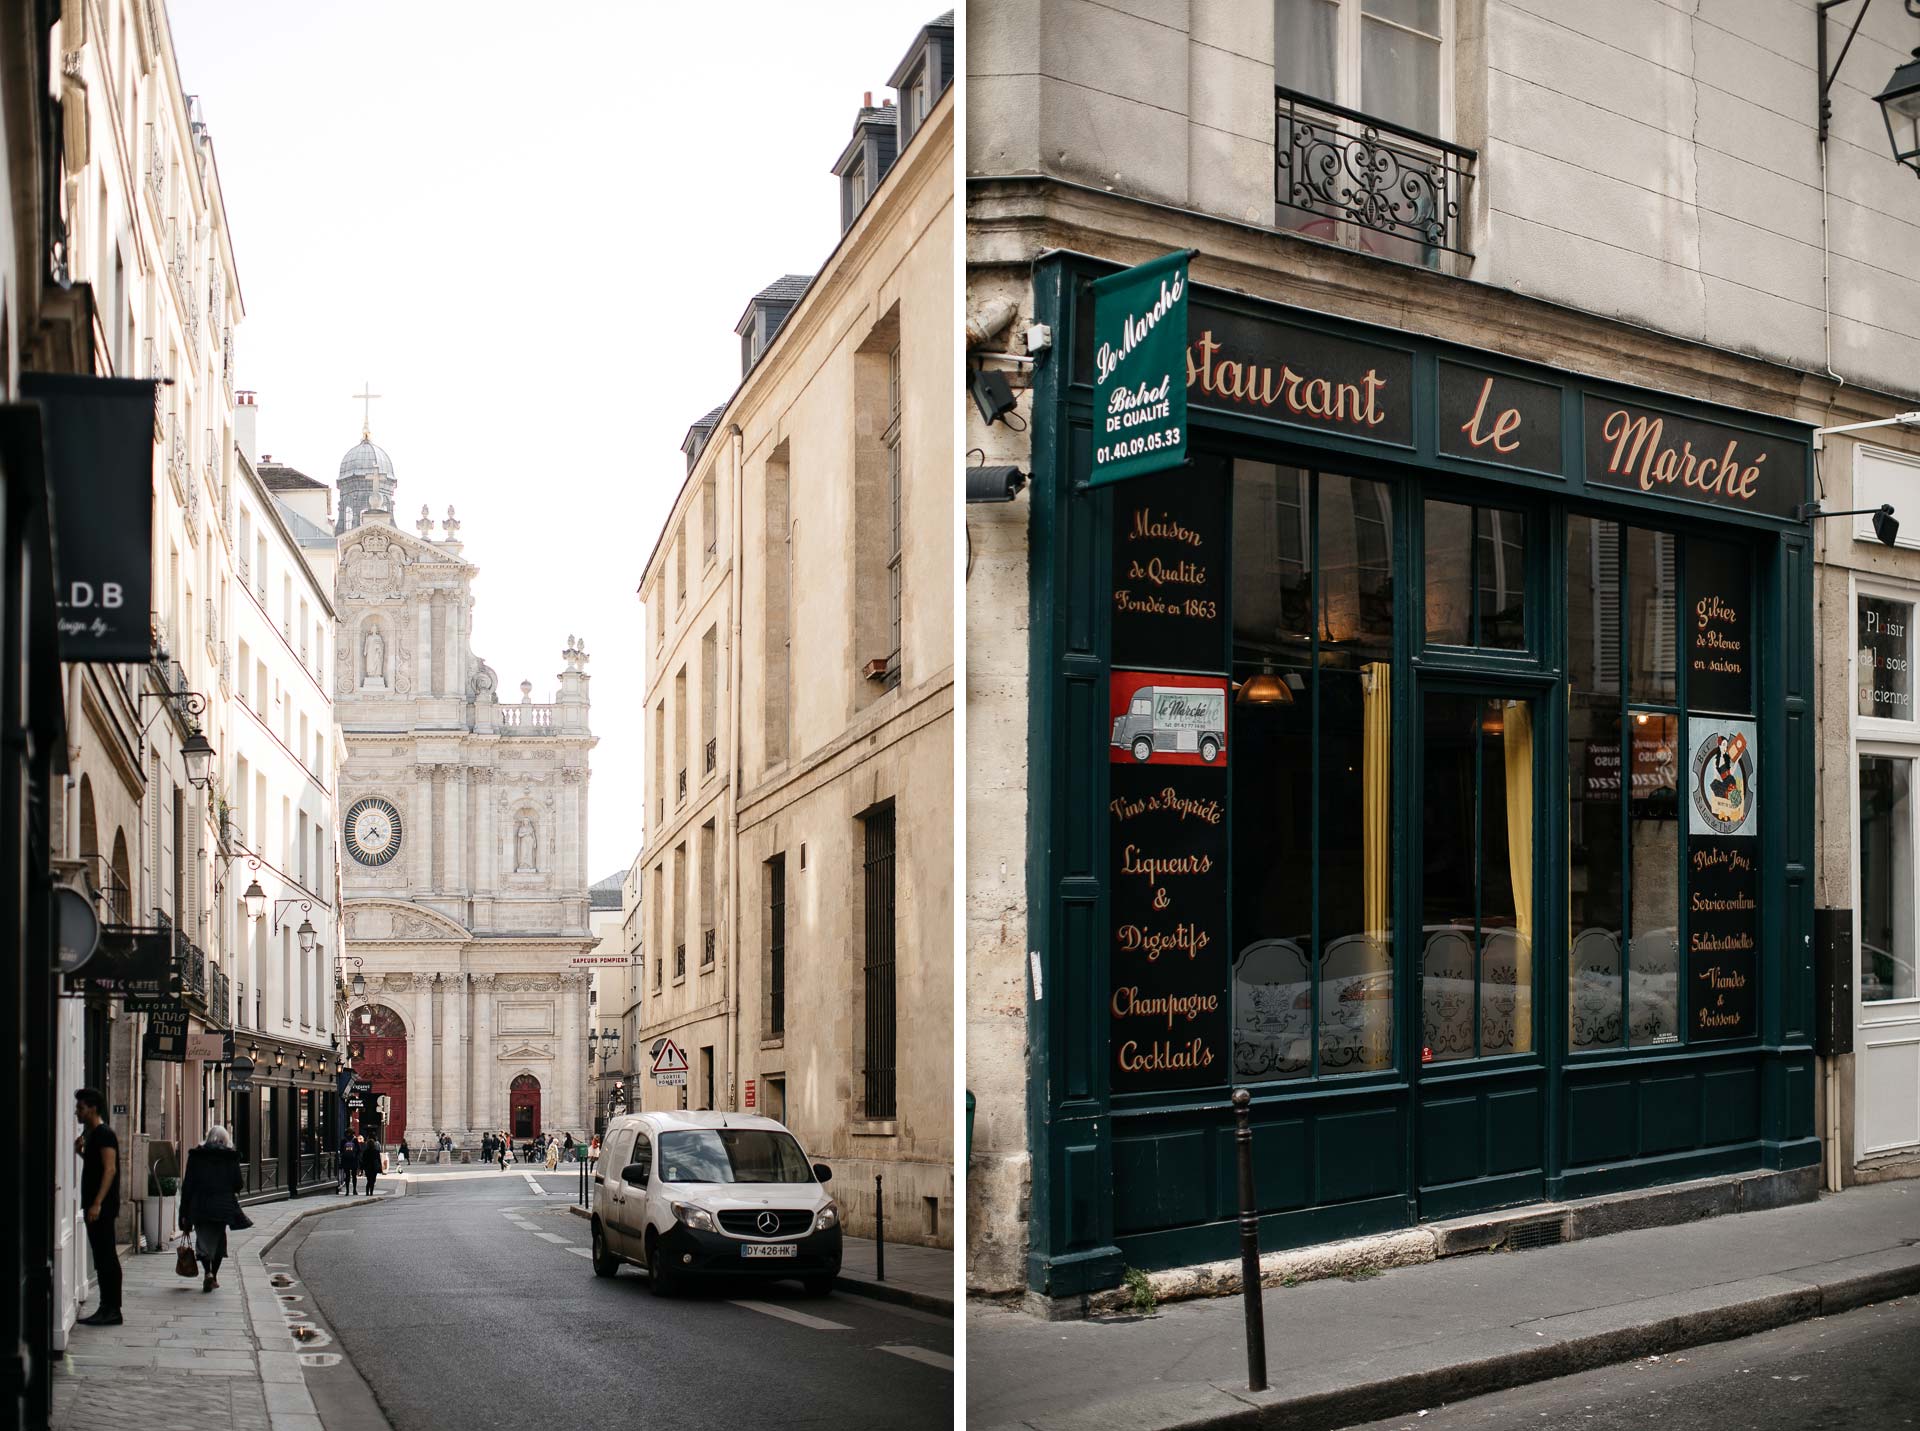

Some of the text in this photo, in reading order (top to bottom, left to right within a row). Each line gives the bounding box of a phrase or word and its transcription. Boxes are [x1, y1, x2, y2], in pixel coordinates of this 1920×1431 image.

[1097, 270, 1184, 385] Le Marché
[1186, 330, 1387, 427] staurant
[1107, 374, 1170, 414] Bistrot
[1106, 399, 1170, 433] DE QUALITÉ
[1097, 427, 1181, 464] 01.40.09.05.33
[1603, 410, 1767, 499] Marché
[1129, 507, 1203, 546] Maison
[1129, 557, 1208, 586] de Qualité
[1114, 590, 1217, 619] Fondée en 1863
[1866, 611, 1905, 637] Plaisir
[1696, 630, 1741, 650] de Potence
[1694, 657, 1742, 673] en saison
[1886, 653, 1908, 671] soie
[1169, 699, 1207, 717] Marché
[1861, 685, 1910, 706] ancienne
[1697, 742, 1711, 763] Bar
[1110, 797, 1145, 821] Vins
[1148, 797, 1161, 811] de
[1696, 796, 1711, 822] Salon
[1120, 844, 1213, 885] Liqueurs
[1693, 848, 1718, 870] Plat
[1729, 850, 1751, 871] Jour
[1153, 887, 1171, 911] &
[1692, 892, 1726, 911] Service
[1118, 923, 1210, 960] Digestifs
[1699, 966, 1746, 989] Viandes
[130, 1002, 176, 1010] LAFONT
[1111, 986, 1218, 1029] Champagne
[1699, 1007, 1741, 1028] Poissons
[153, 1021, 182, 1036] Thai
[1119, 1038, 1214, 1071] Cocktails
